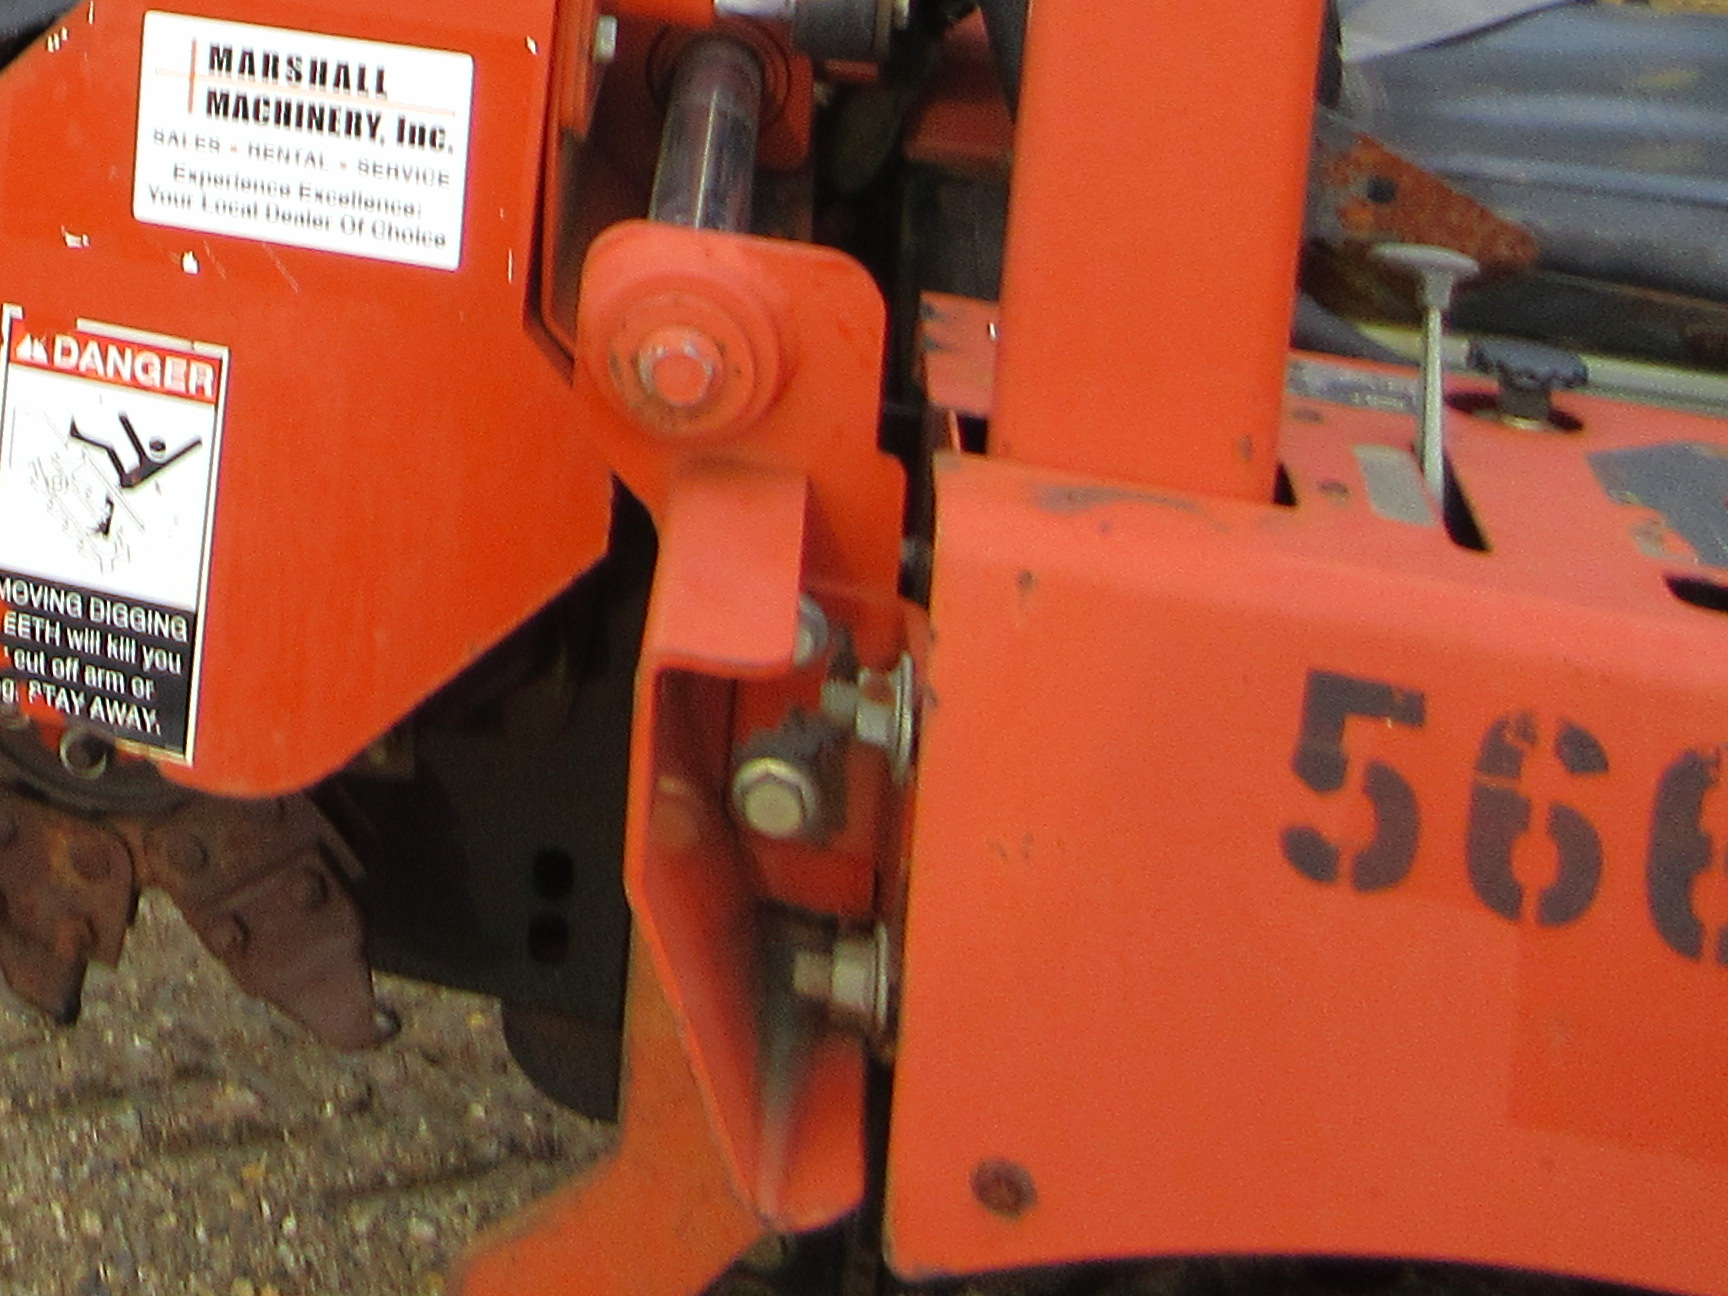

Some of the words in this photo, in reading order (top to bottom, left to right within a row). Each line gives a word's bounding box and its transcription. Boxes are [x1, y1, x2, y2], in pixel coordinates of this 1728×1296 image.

[208, 41, 388, 100] MARSHALL
[205, 86, 385, 146] MACHINERY,
[396, 113, 455, 155] Inc.
[153, 127, 221, 154] SALES
[247, 140, 329, 172] RENTAL
[357, 157, 450, 189] SERVICE
[172, 161, 292, 199] Experience
[148, 182, 194, 210] Your
[201, 190, 259, 220] Local
[265, 201, 333, 231] Dealer
[371, 218, 447, 251] Choice
[53, 332, 216, 398] DANGER
[2, 610, 62, 647] EETH
[66, 627, 102, 657] will
[106, 633, 137, 665] kill
[142, 644, 183, 676] you
[89, 595, 189, 643] DIGGING
[13, 647, 46, 676] cut
[51, 655, 81, 683] off
[83, 663, 127, 696] arm
[130, 675, 156, 702] or
[89, 694, 162, 737] AWAY.
